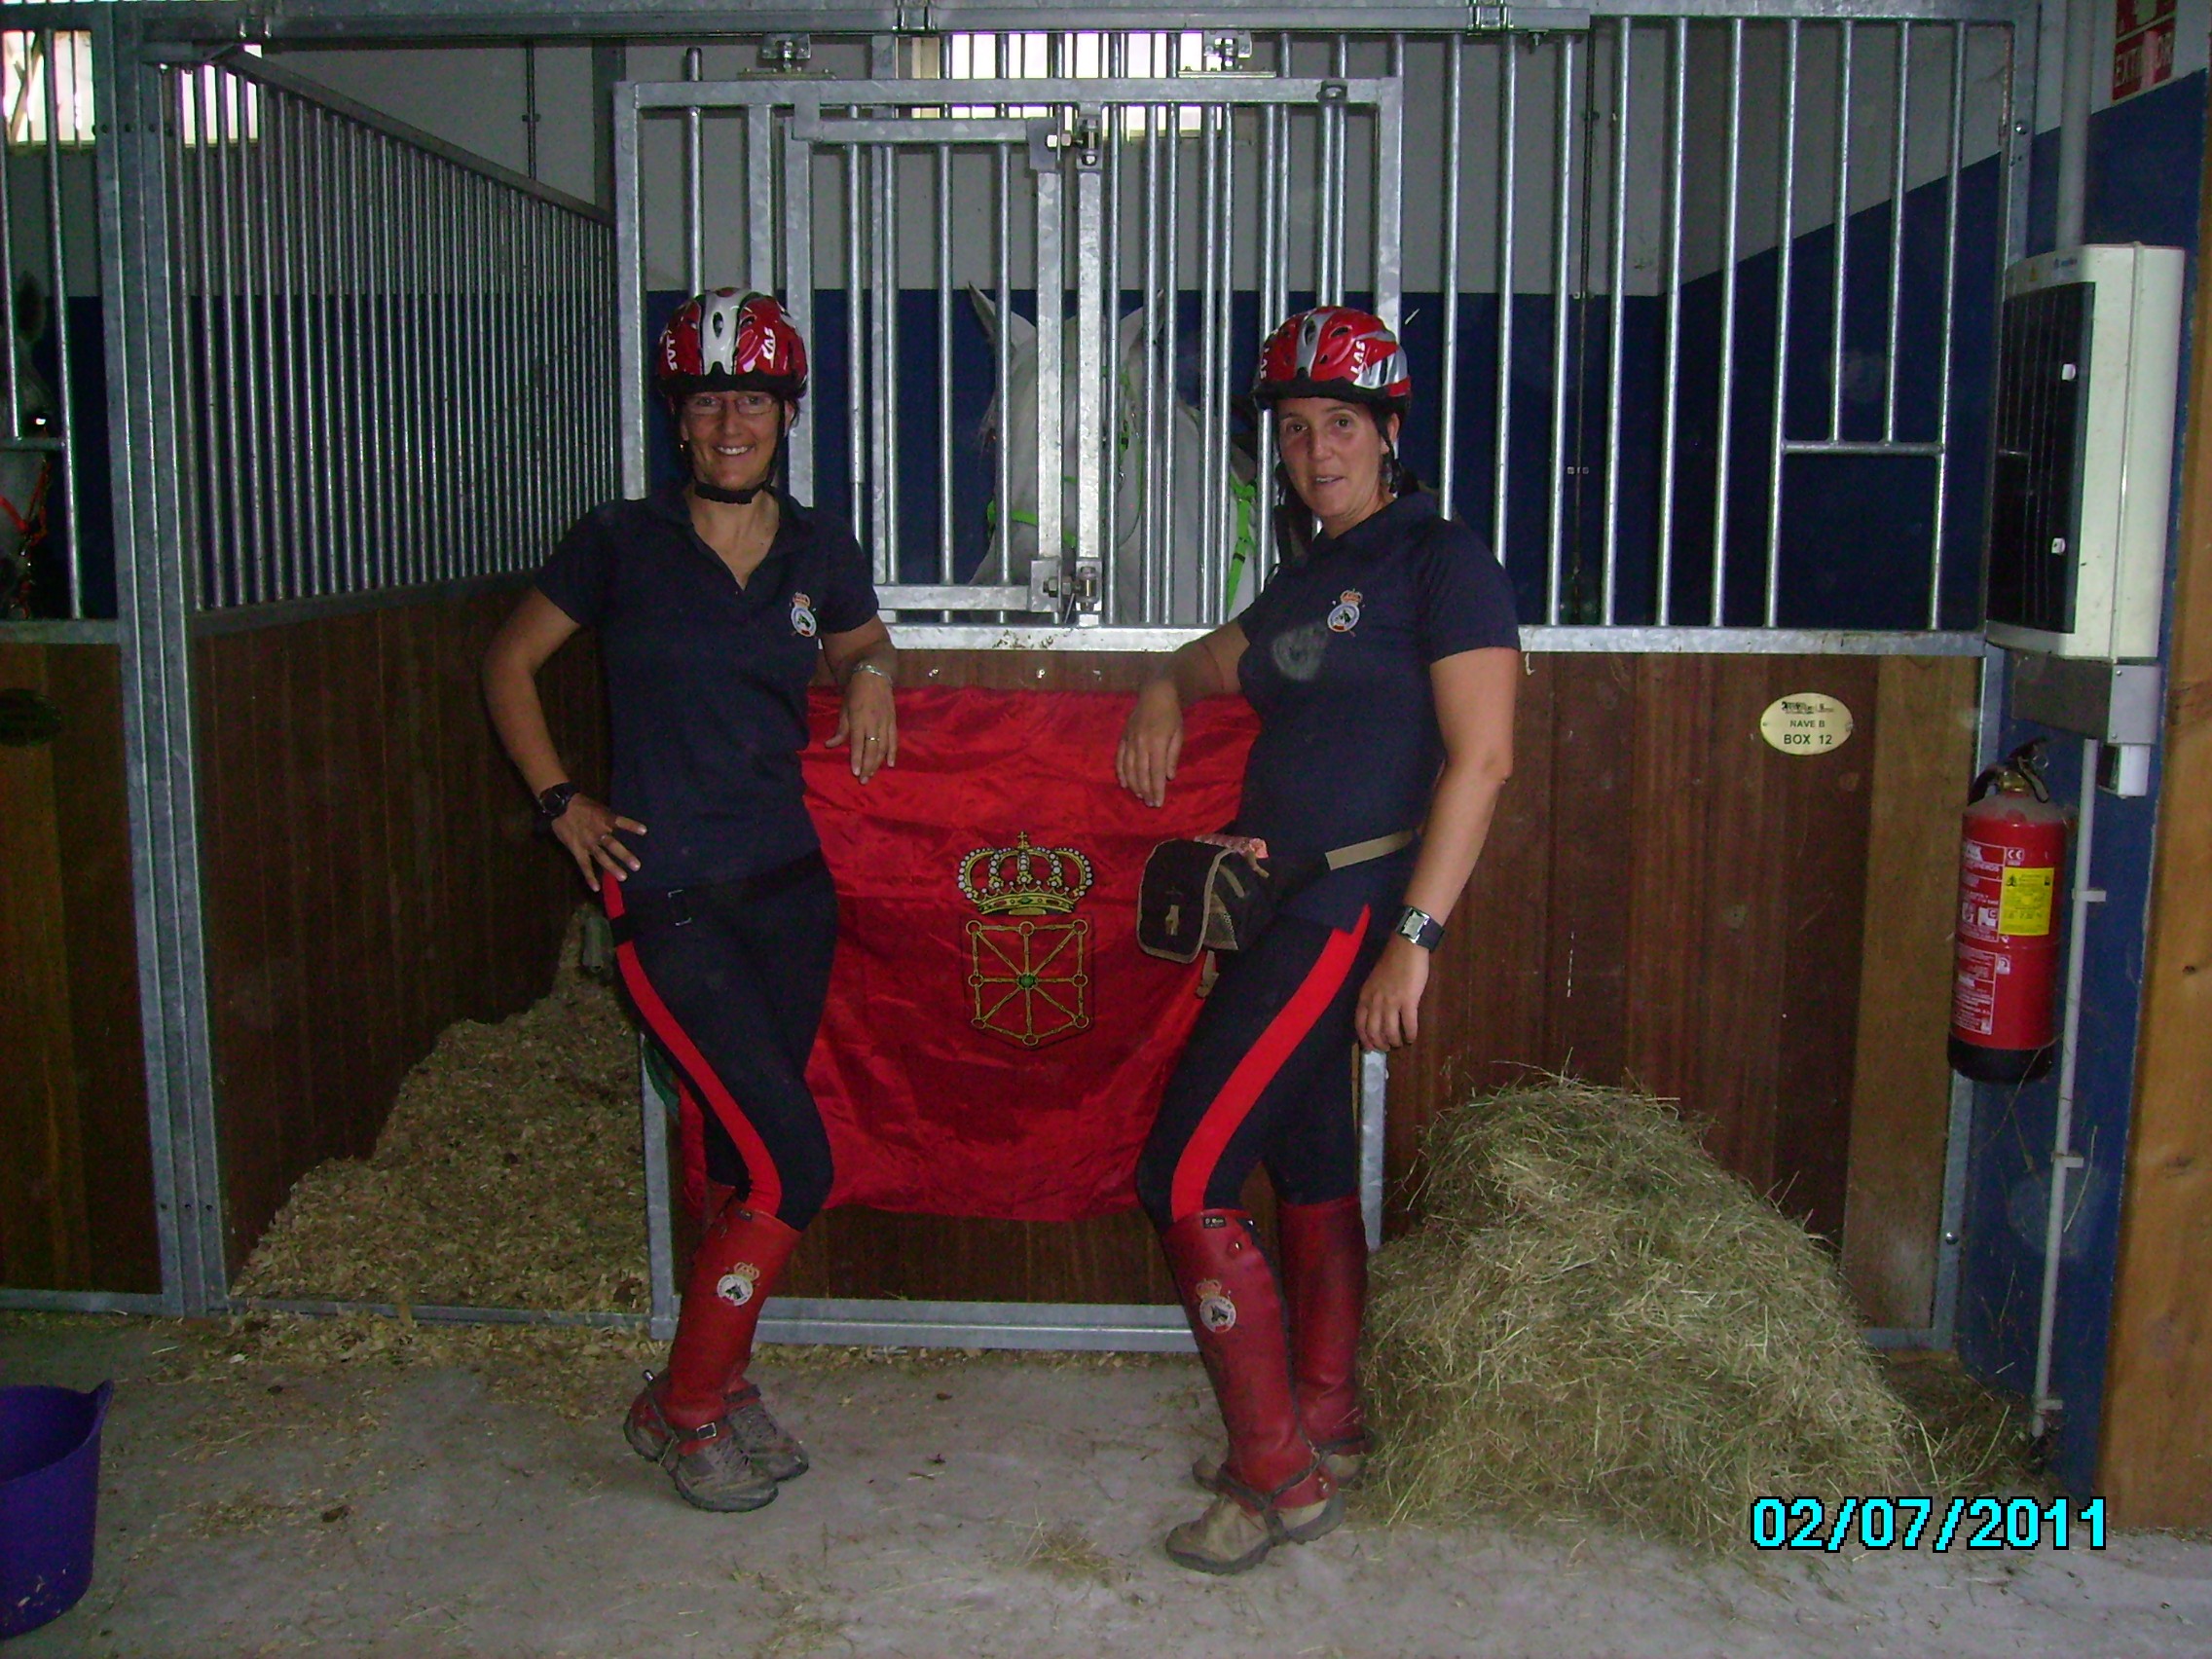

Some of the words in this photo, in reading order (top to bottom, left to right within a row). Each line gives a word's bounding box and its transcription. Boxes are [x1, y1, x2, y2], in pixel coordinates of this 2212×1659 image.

[1350, 341, 1366, 375] LAS
[1789, 719, 1816, 728] NAVE
[1818, 719, 1825, 728] B
[1784, 734, 1811, 745] BOX
[1819, 734, 1832, 745] 12
